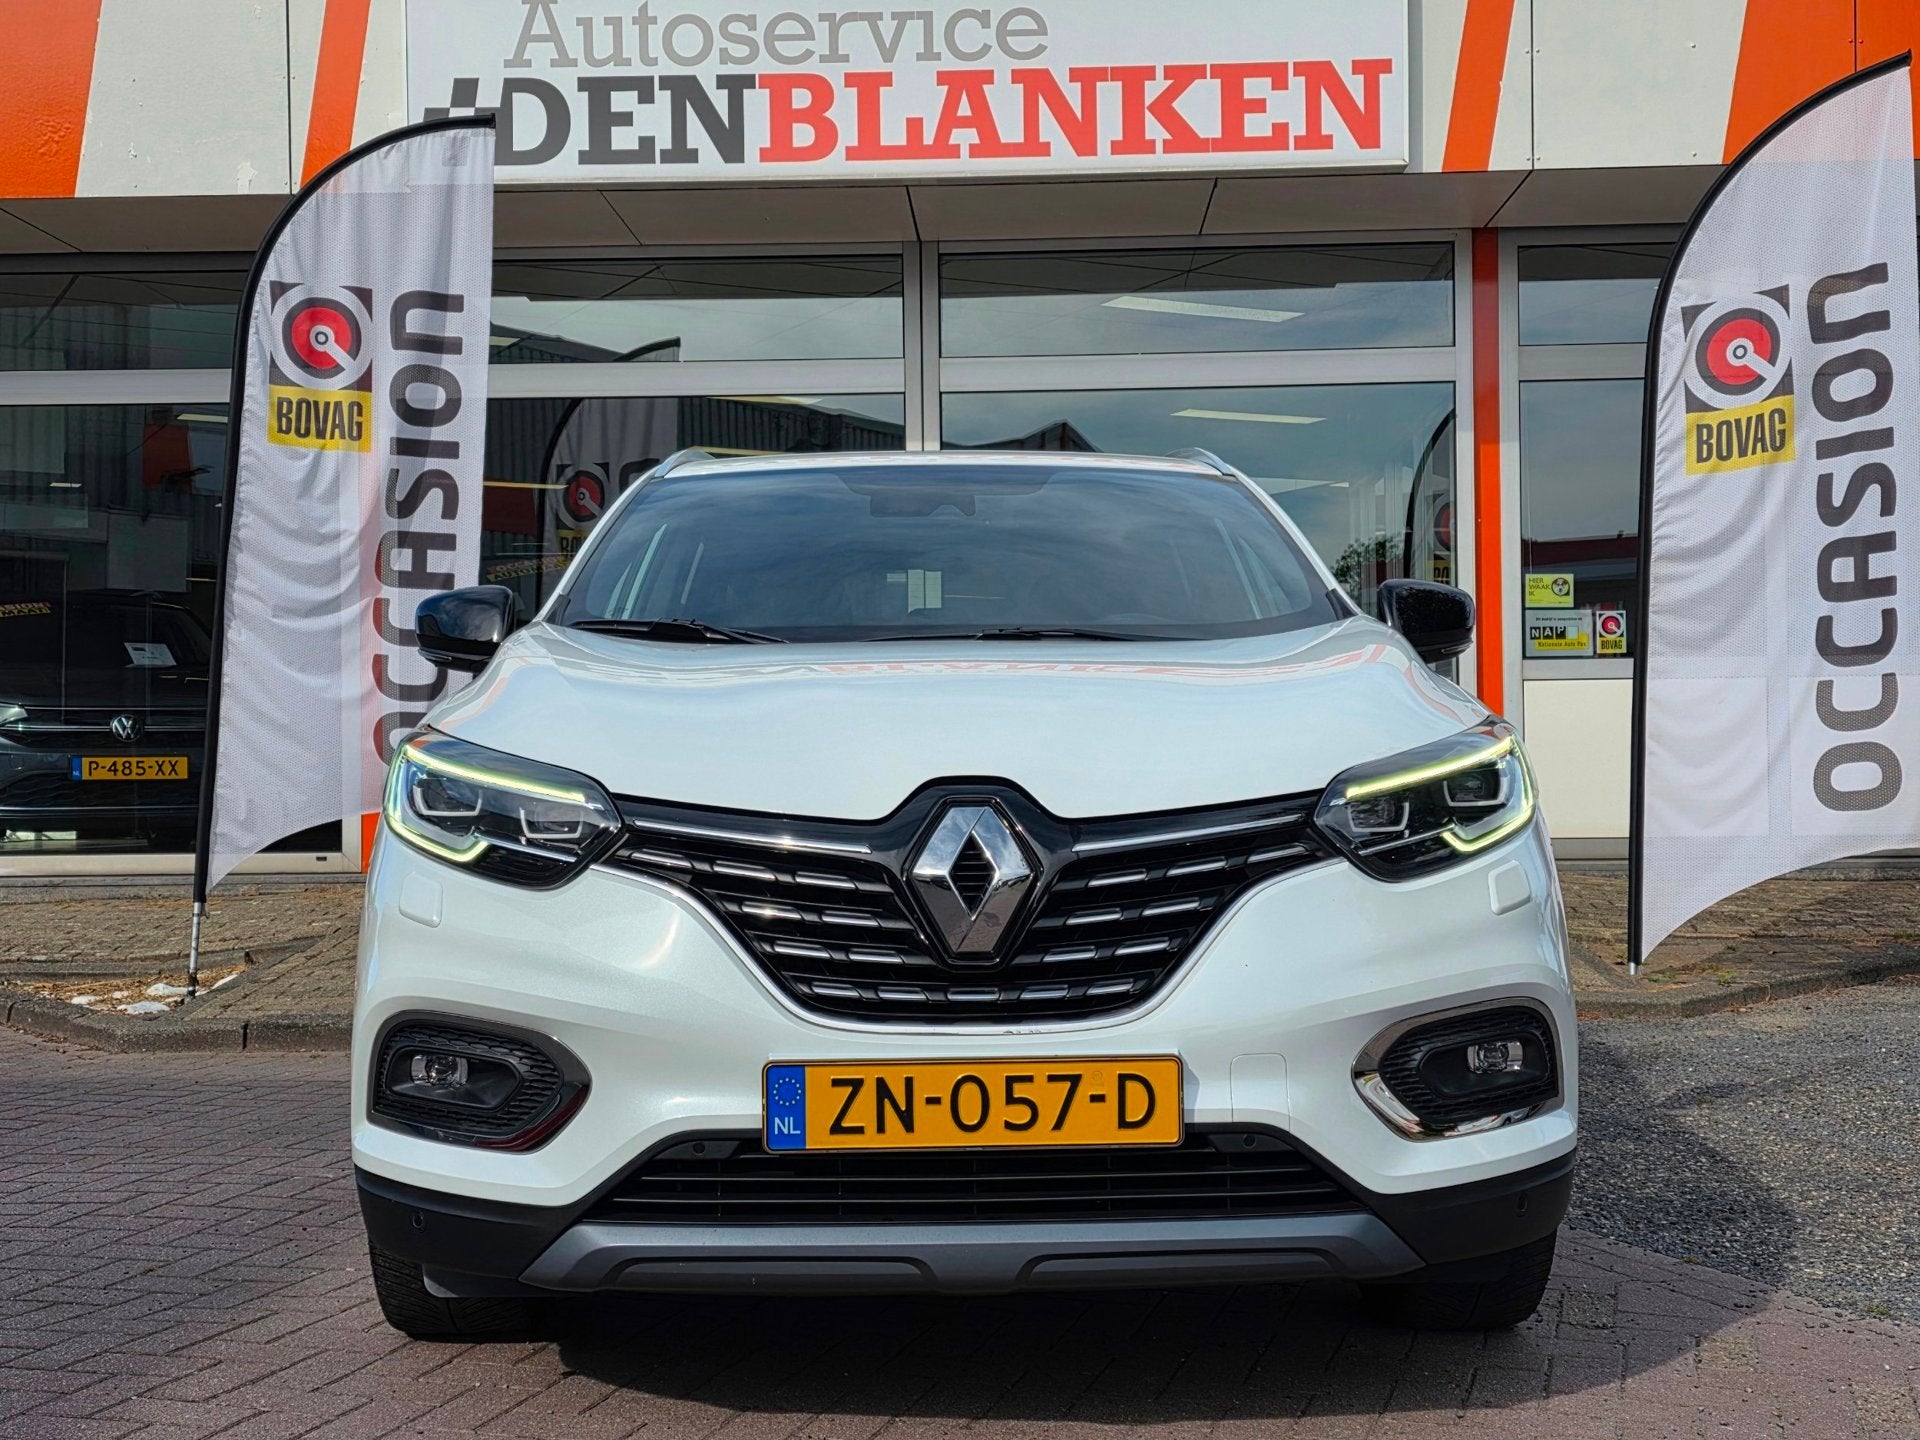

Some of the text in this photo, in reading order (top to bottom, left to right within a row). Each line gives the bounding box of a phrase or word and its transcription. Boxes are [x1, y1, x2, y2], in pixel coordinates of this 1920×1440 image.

[504, 0, 1048, 68] Autoservice
[277, 397, 363, 441] BOVAG
[1696, 408, 1786, 463] BOVAG
[1531, 626, 1565, 639] NAP
[1601, 639, 1623, 650] BOVAG
[88, 760, 179, 777] P-485-XX
[773, 1072, 1157, 1136] NL ZN-057-D
